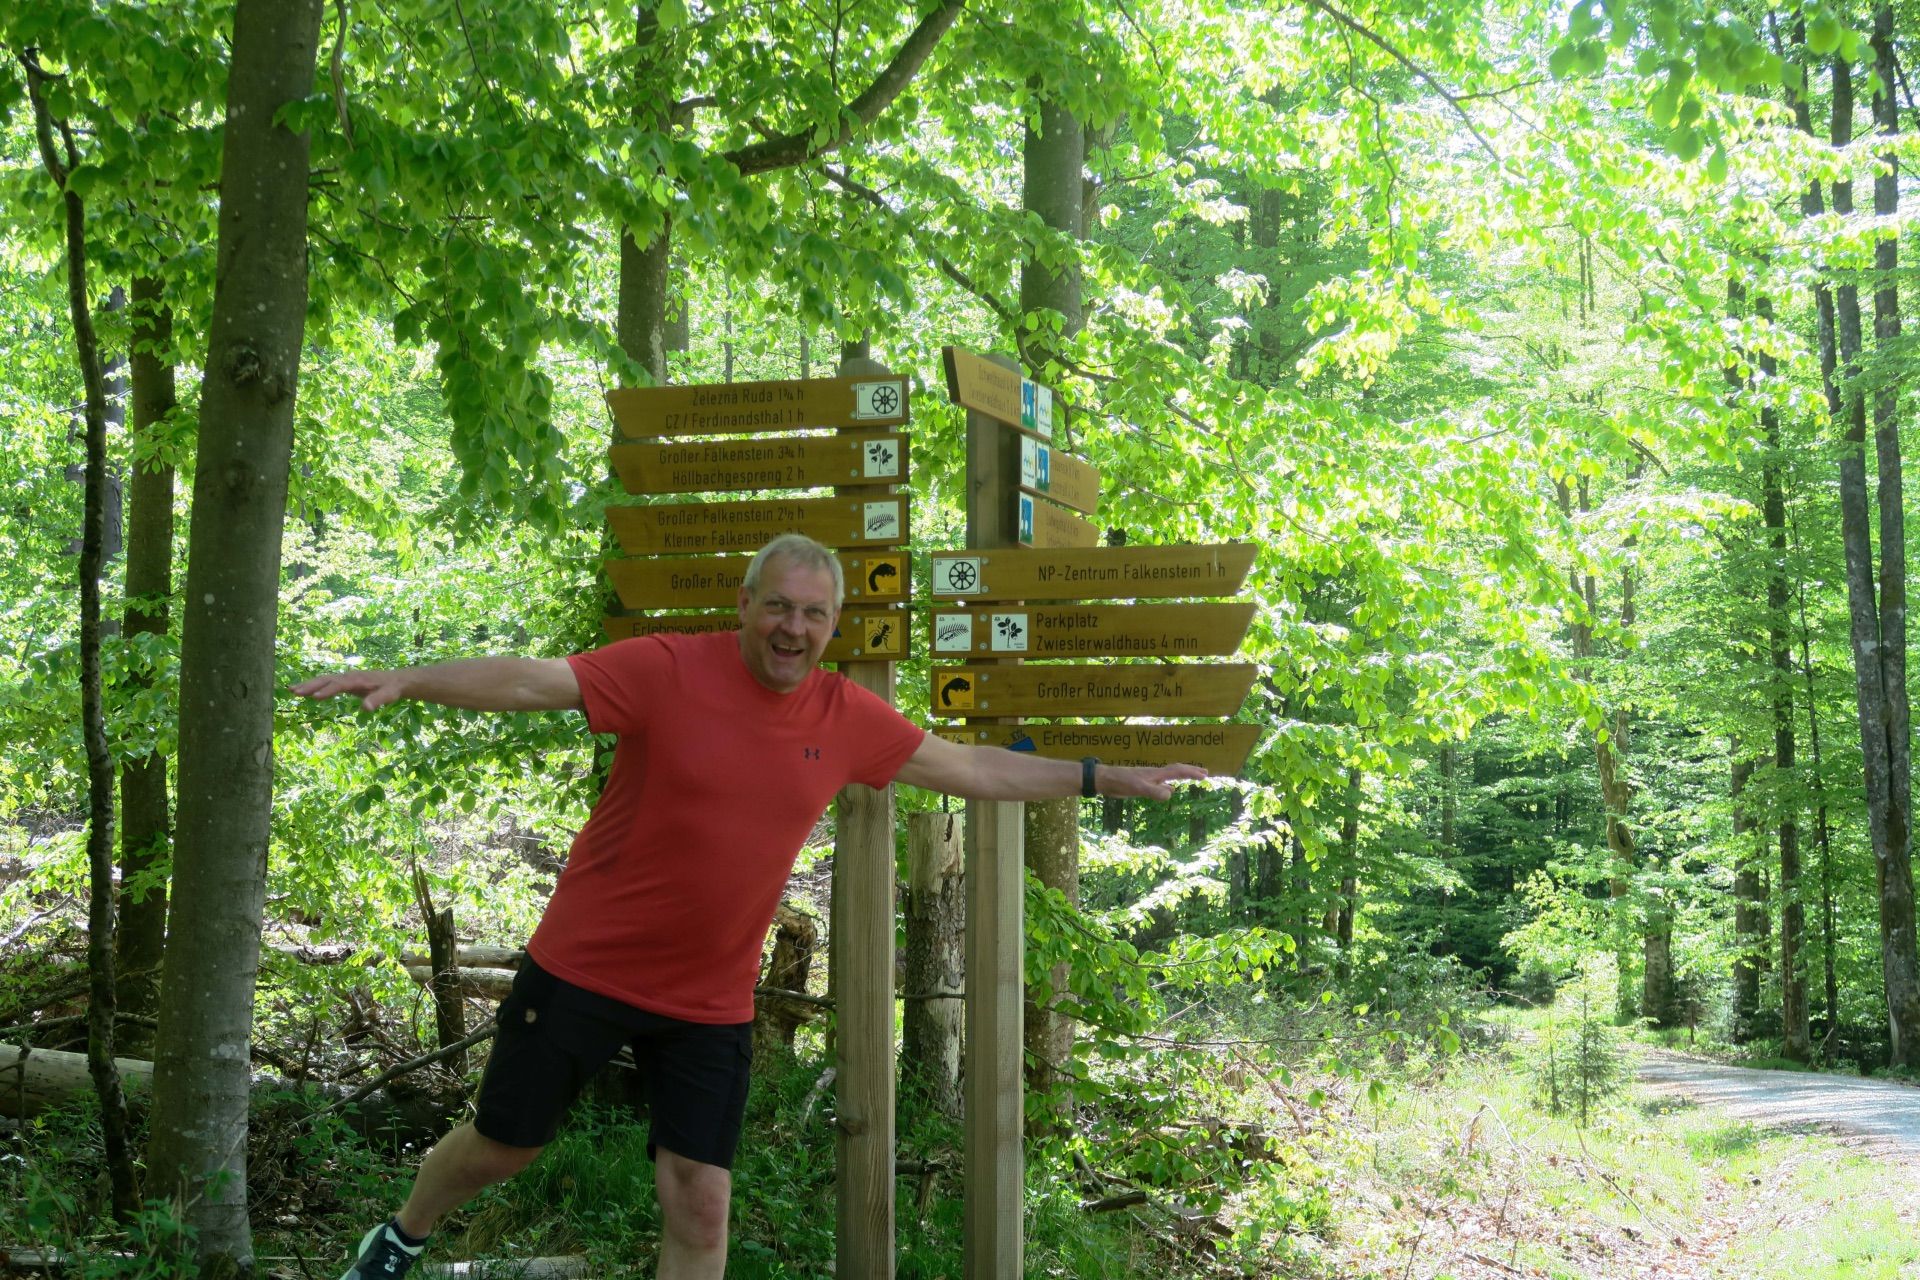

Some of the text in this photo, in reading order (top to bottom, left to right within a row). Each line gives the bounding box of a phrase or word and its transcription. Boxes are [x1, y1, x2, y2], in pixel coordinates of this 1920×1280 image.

[742, 387, 773, 404] Ruda
[797, 386, 804, 401] h
[665, 414, 680, 430] CZ
[692, 409, 783, 429] Ferdinandsthal
[787, 410, 792, 424] 1
[797, 407, 804, 422] h
[659, 448, 700, 464] Großer
[704, 446, 774, 463] Falkenstein
[798, 443, 805, 459] h
[672, 465, 804, 488] Höllbachgespreng 2 h
[658, 510, 699, 526] Großer
[703, 508, 773, 525] Falkenstein
[797, 505, 804, 520] h
[664, 532, 707, 548] Kleiner
[1038, 562, 1225, 581] NP-Zentrum Falkenstein 1 h
[671, 574, 712, 590] Großer
[1036, 612, 1098, 632] Parkplatz
[1036, 634, 1156, 651] Zwieslerwaldhaus
[1161, 633, 1168, 649] 4
[1173, 634, 1198, 649] min
[1038, 682, 1082, 698] Großer
[1087, 681, 1148, 702] Rundweg
[1175, 681, 1182, 697] h
[1043, 731, 1224, 749] Erlebnisweg Waldwandel
